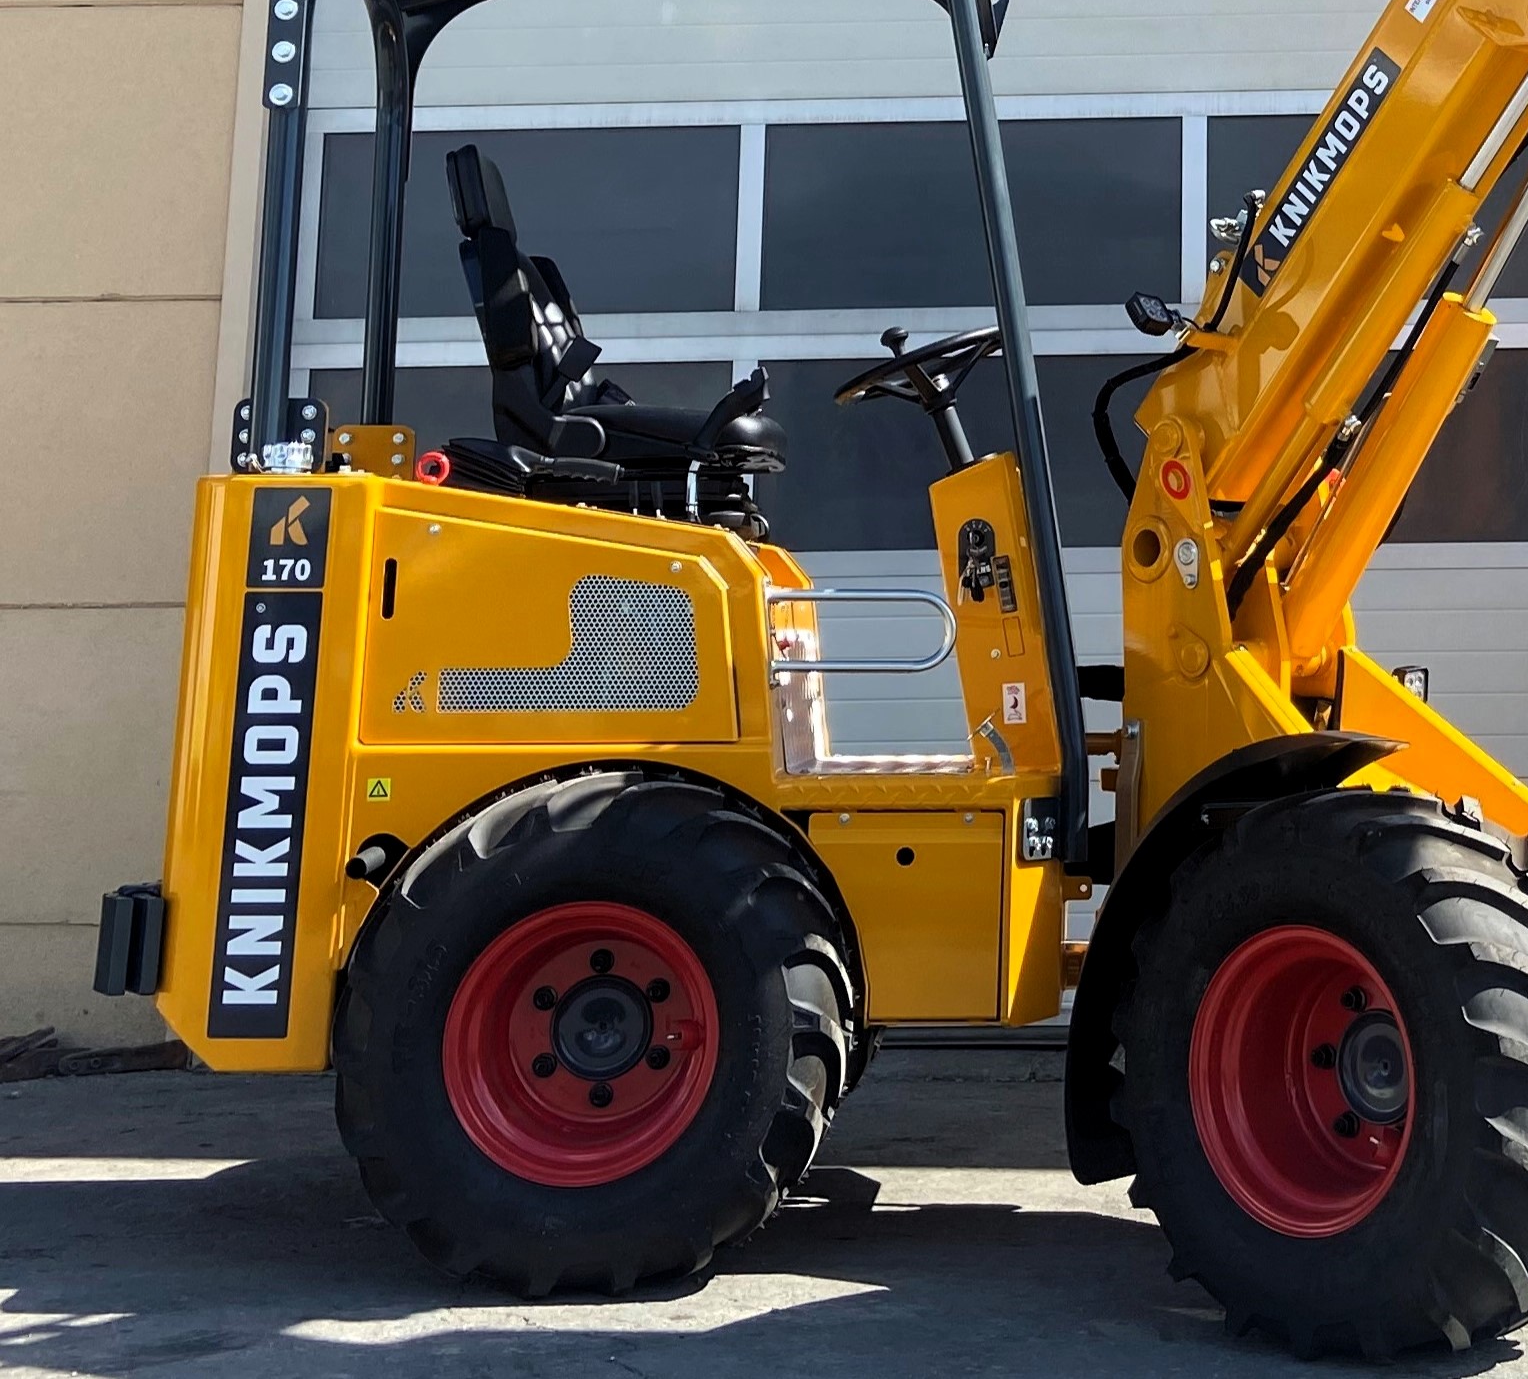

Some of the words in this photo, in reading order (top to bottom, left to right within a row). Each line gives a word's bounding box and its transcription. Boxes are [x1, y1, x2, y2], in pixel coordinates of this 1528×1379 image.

[1268, 63, 1390, 248] KNIKMOPS
[260, 558, 311, 582] 170
[221, 623, 308, 1006] KNIKMOPS
